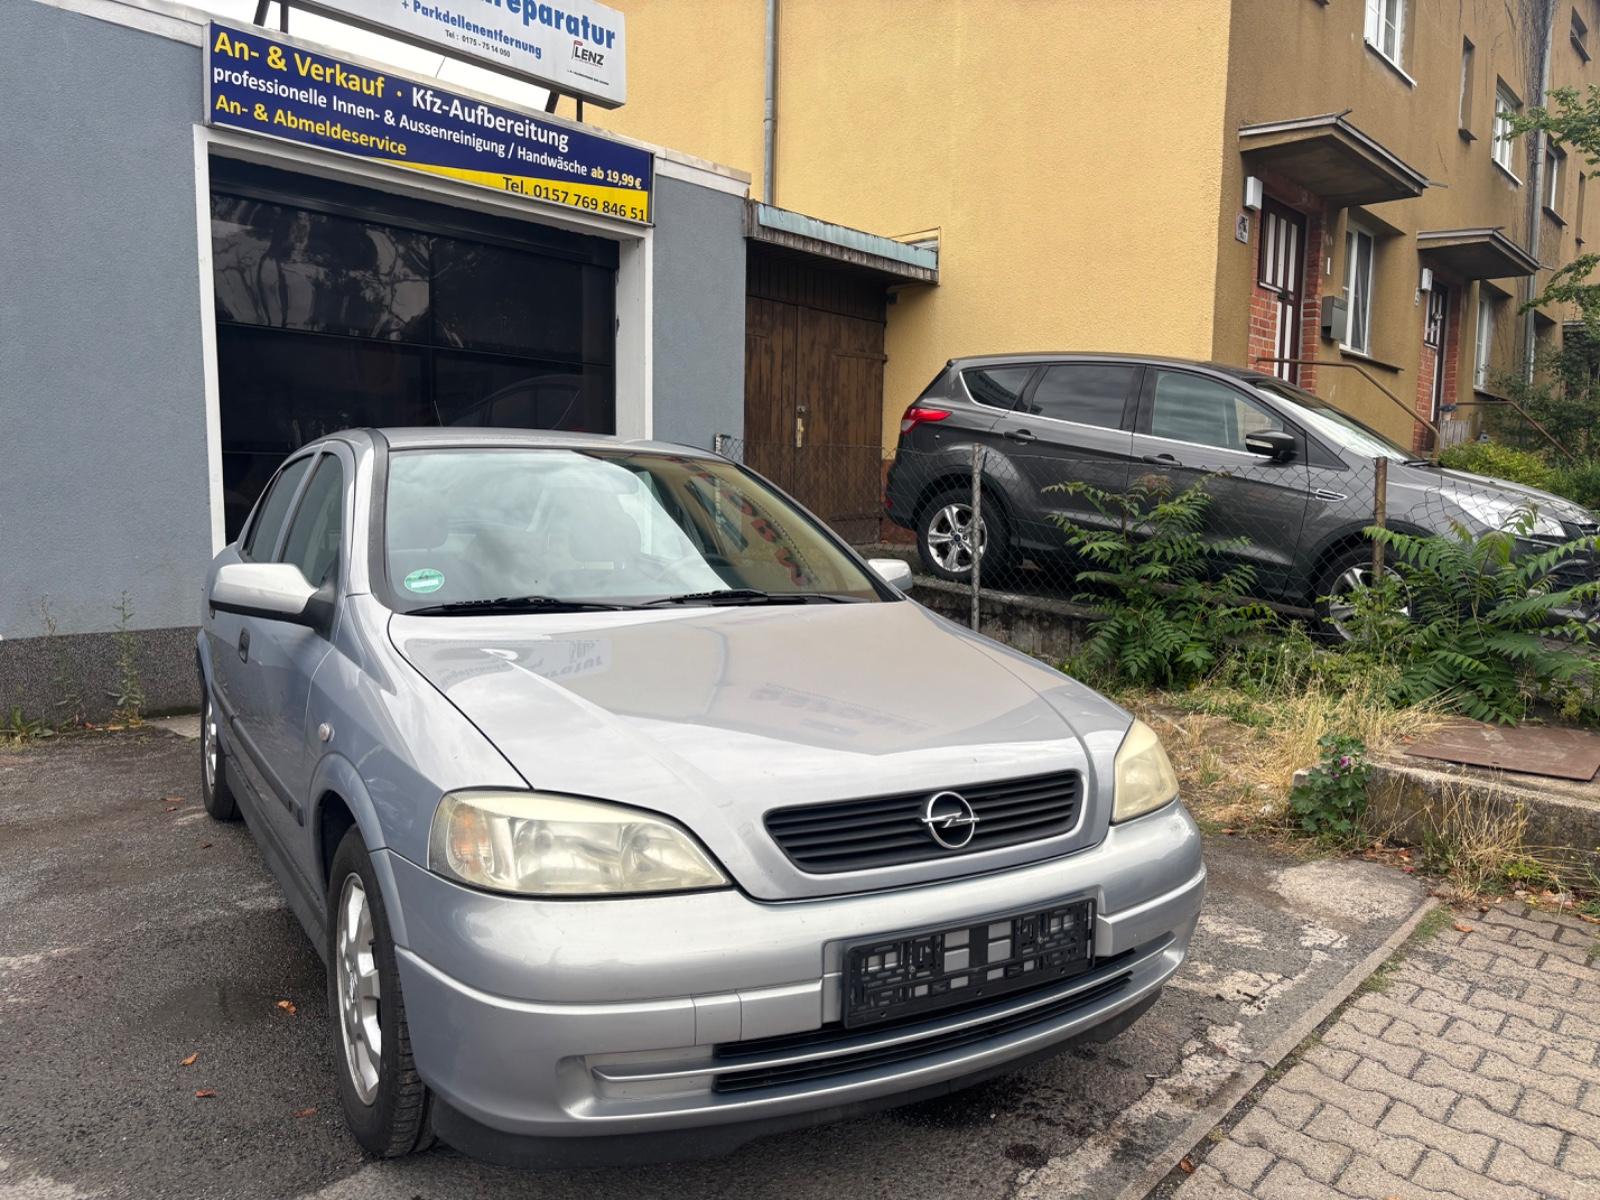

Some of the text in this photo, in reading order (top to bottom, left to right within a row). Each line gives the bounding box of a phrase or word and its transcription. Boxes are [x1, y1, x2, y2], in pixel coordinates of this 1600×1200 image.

[413, 0, 542, 59] Parkdellenentfernung
[462, 35, 477, 46] 0175
[574, 46, 604, 66] LENZ
[214, 32, 259, 61] An-
[267, 45, 287, 72] &
[294, 52, 385, 98] Verkauf
[412, 86, 569, 153] Kfz-Aufbereitung
[213, 66, 327, 108] professionelle
[333, 95, 381, 121] Innen-
[384, 109, 396, 127] &
[399, 114, 505, 158] Aussenreinigung
[517, 145, 588, 176] Handwäsche
[591, 166, 604, 180] ab
[215, 94, 407, 156] An- & Abmeldeservice
[503, 176, 645, 222] Tel. 0157 769 846 51
